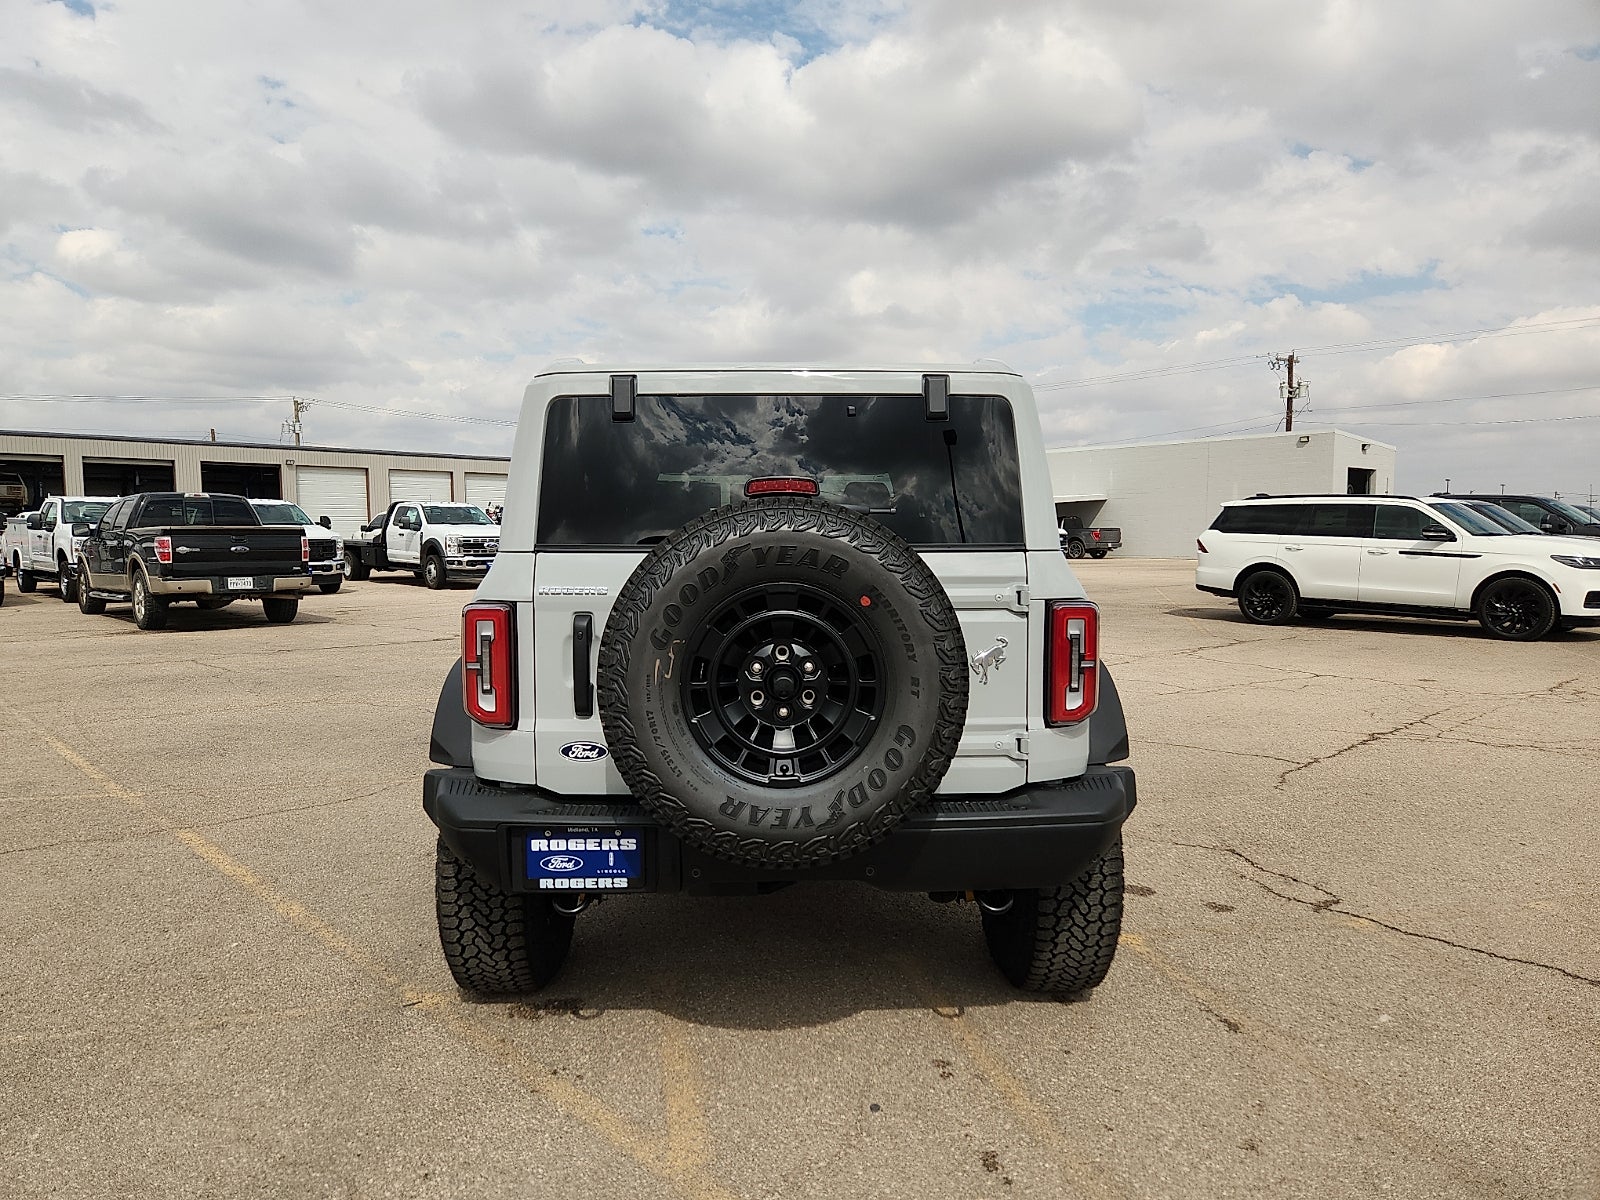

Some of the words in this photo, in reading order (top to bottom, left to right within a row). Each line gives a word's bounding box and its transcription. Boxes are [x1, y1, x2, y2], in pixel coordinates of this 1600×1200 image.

[910, 676, 920, 699] RT
[645, 709, 683, 778] LT315/70R17
[568, 745, 599, 759] Ford
[531, 838, 637, 851] ROGERS
[547, 857, 576, 869] Ford
[539, 877, 628, 889] ROGERS
